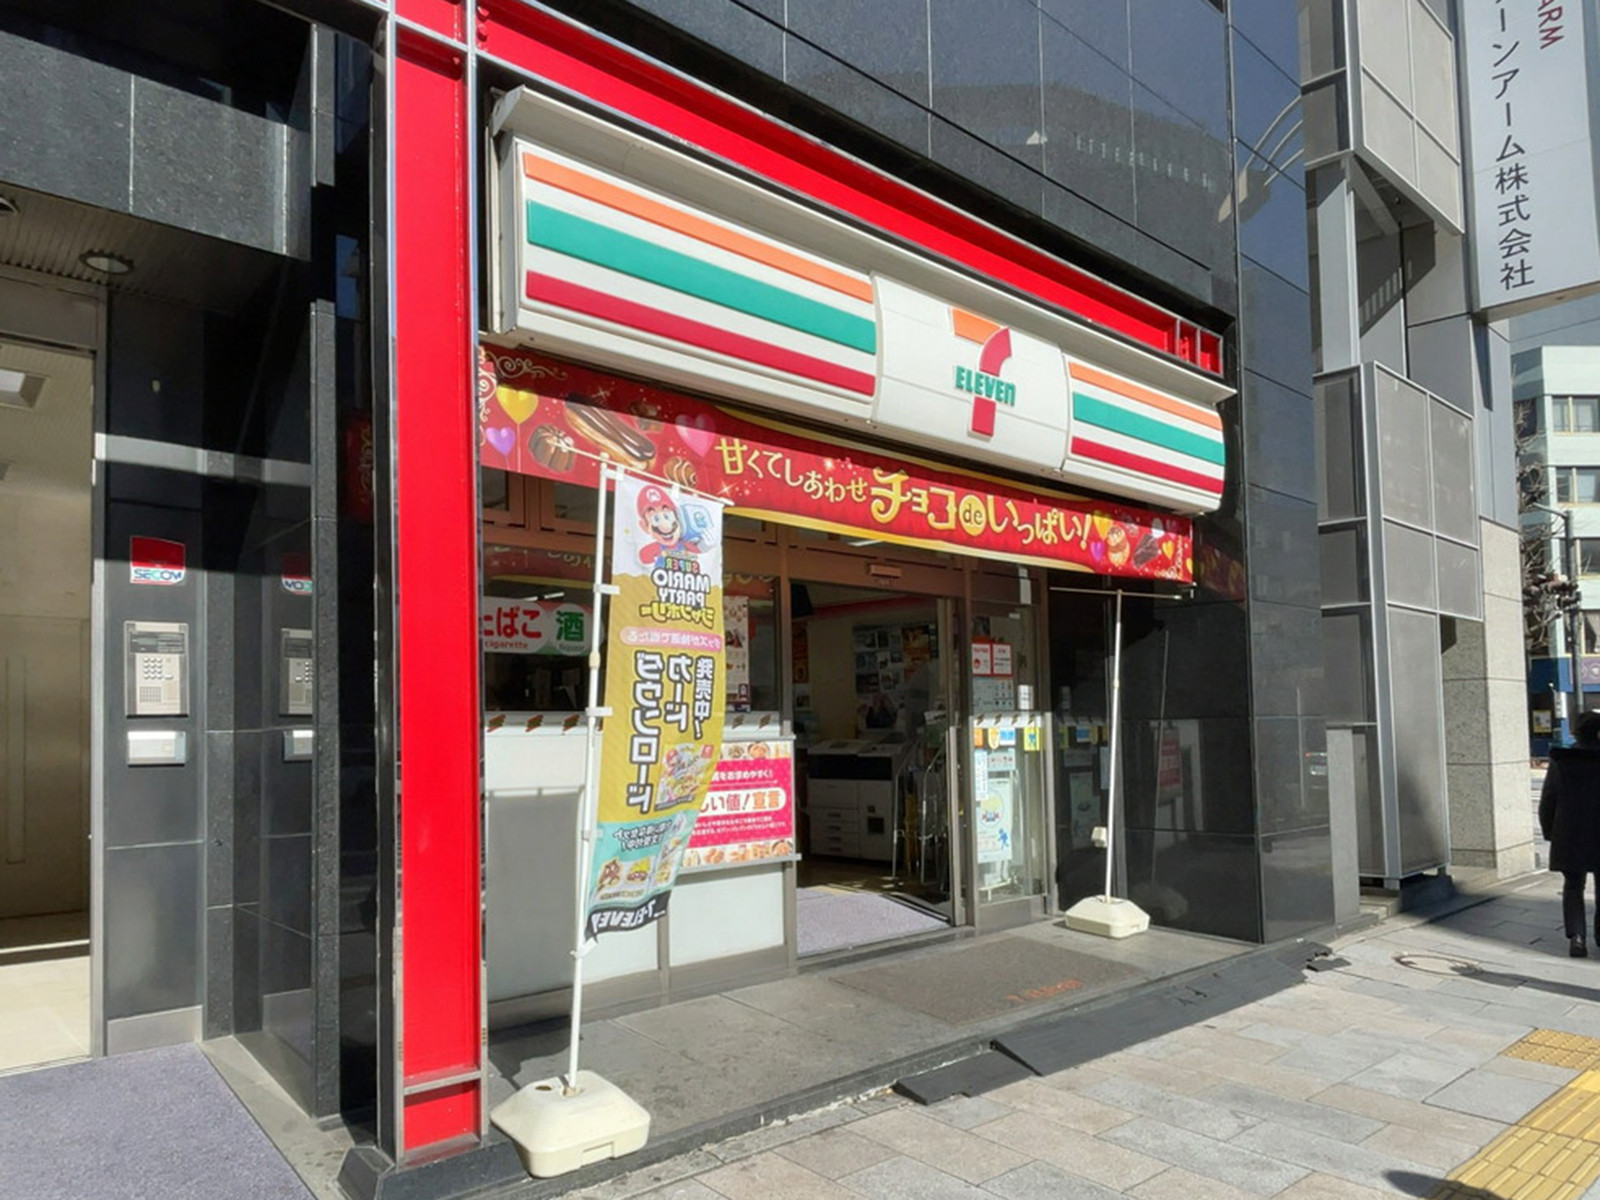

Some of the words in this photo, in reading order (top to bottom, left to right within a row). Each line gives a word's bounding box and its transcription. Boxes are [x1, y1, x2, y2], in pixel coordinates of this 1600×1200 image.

[1492, 0, 1536, 290] ーンアーム株式会社
[133, 567, 184, 580] SECOM
[556, 610, 584, 642] 酒
